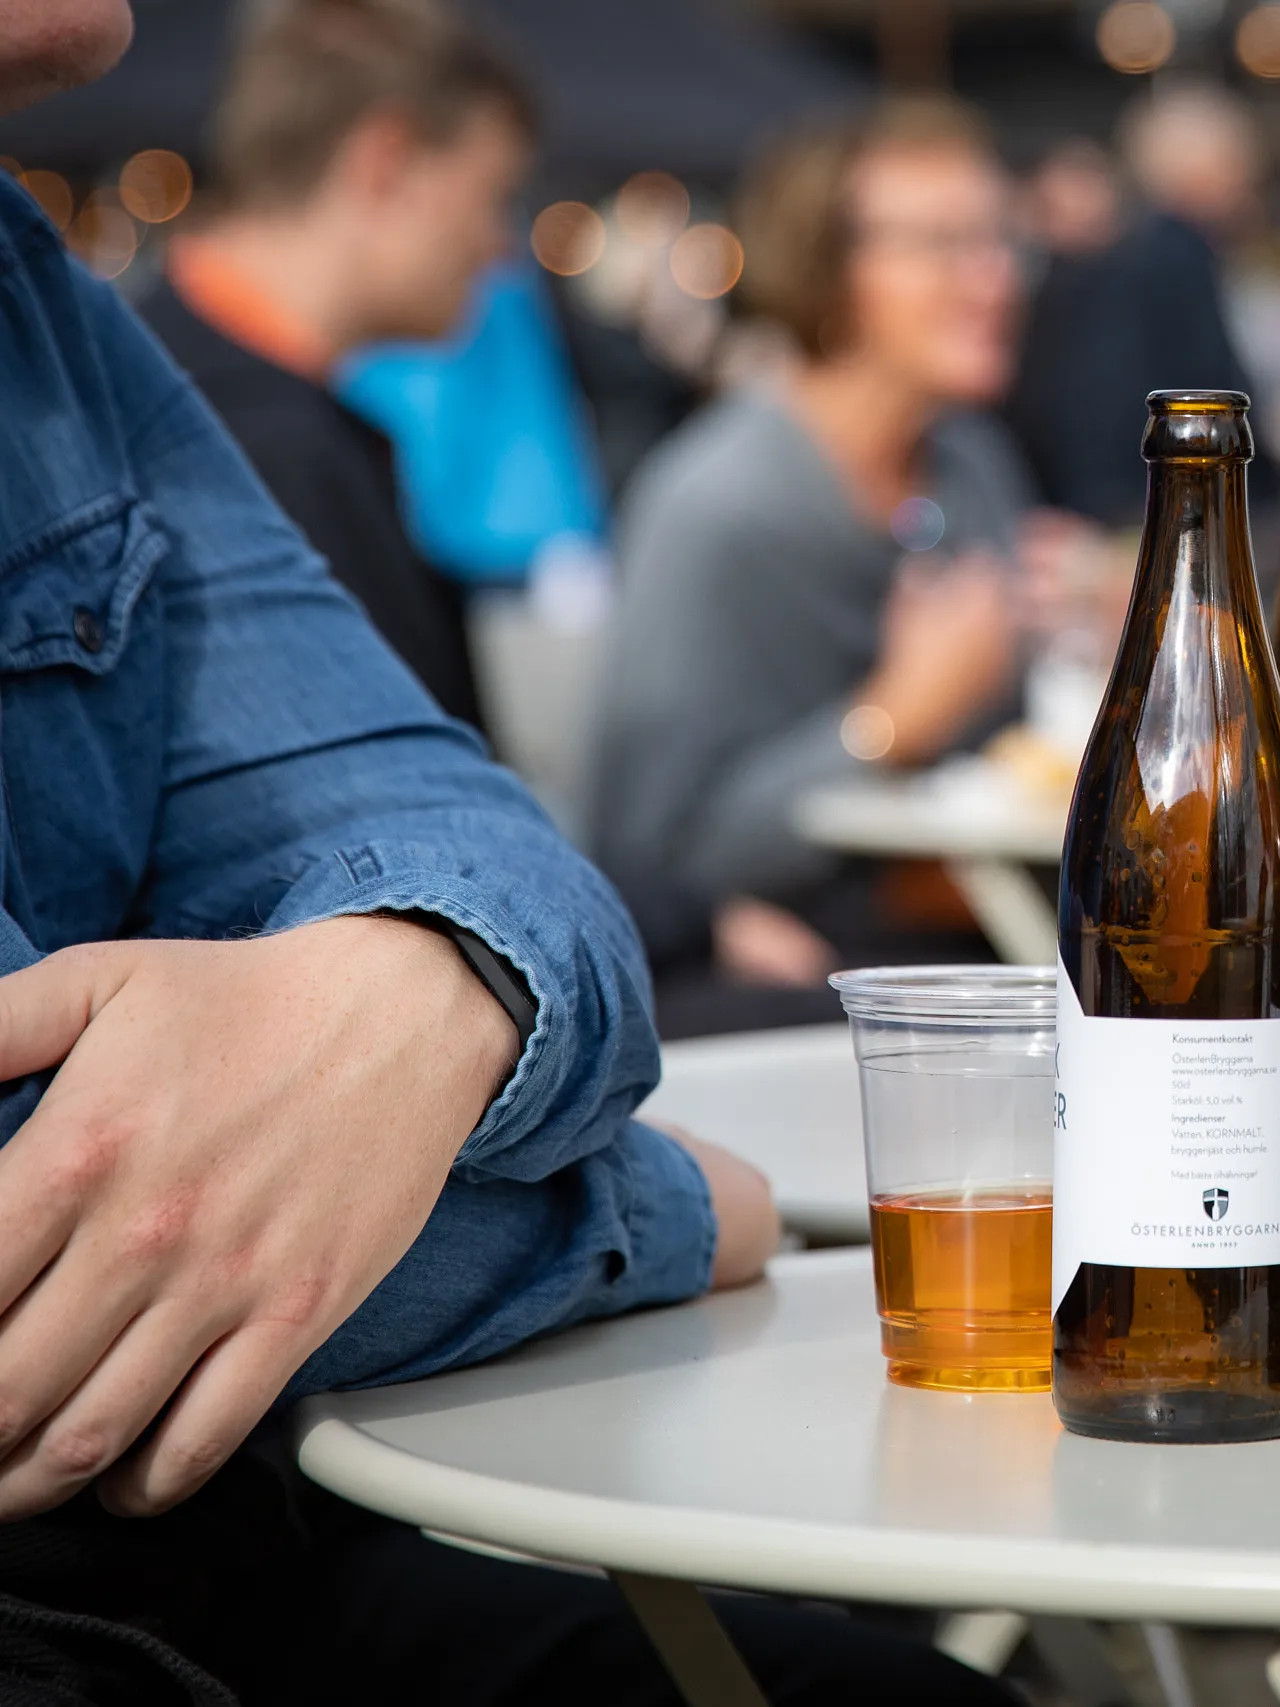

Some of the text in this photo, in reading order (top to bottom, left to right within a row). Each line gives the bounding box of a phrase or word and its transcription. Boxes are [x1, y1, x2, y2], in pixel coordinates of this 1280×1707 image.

[1172, 1033, 1253, 1044] Konsumentkontakt
[1171, 1112, 1226, 1125] Ingredienser
[1224, 1143, 1241, 1155] och
